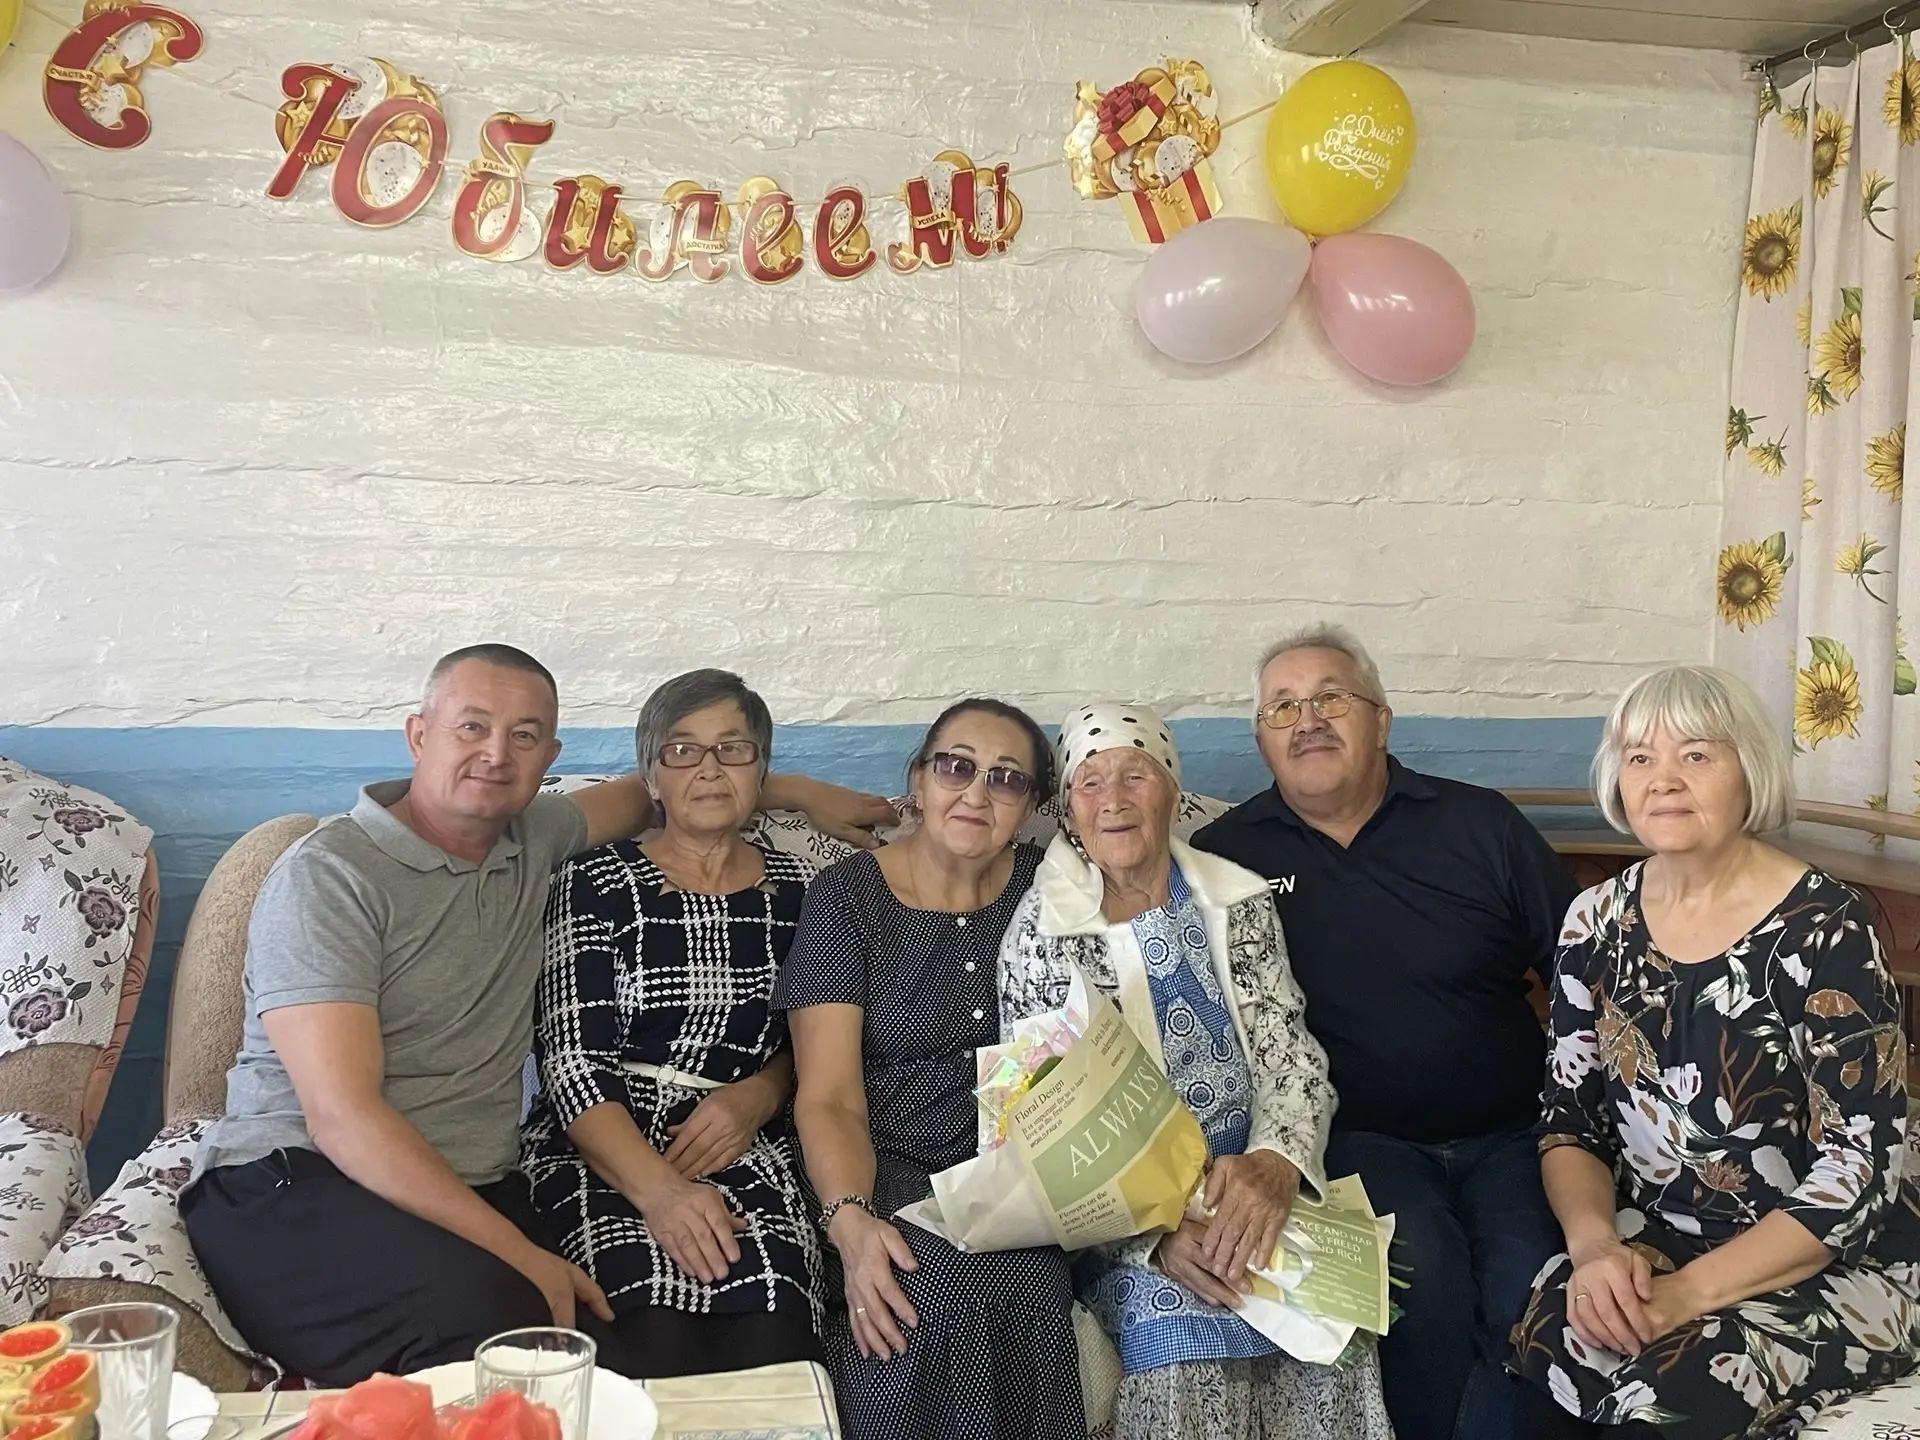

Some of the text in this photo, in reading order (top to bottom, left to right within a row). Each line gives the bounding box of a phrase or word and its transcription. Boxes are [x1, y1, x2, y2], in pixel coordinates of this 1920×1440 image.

[43, 4, 204, 150] С
[1342, 114, 1357, 134] С
[1323, 128, 1392, 171] Рождения
[917, 211, 946, 226] УСПЕХА
[1014, 1098, 1040, 1124] Floral
[1038, 1079, 1065, 1104] Design
[1096, 1191, 1107, 1201] the
[1097, 1200, 1111, 1210] like
[1323, 1226, 1348, 1239] AND
[1336, 1248, 1362, 1264] RICH
